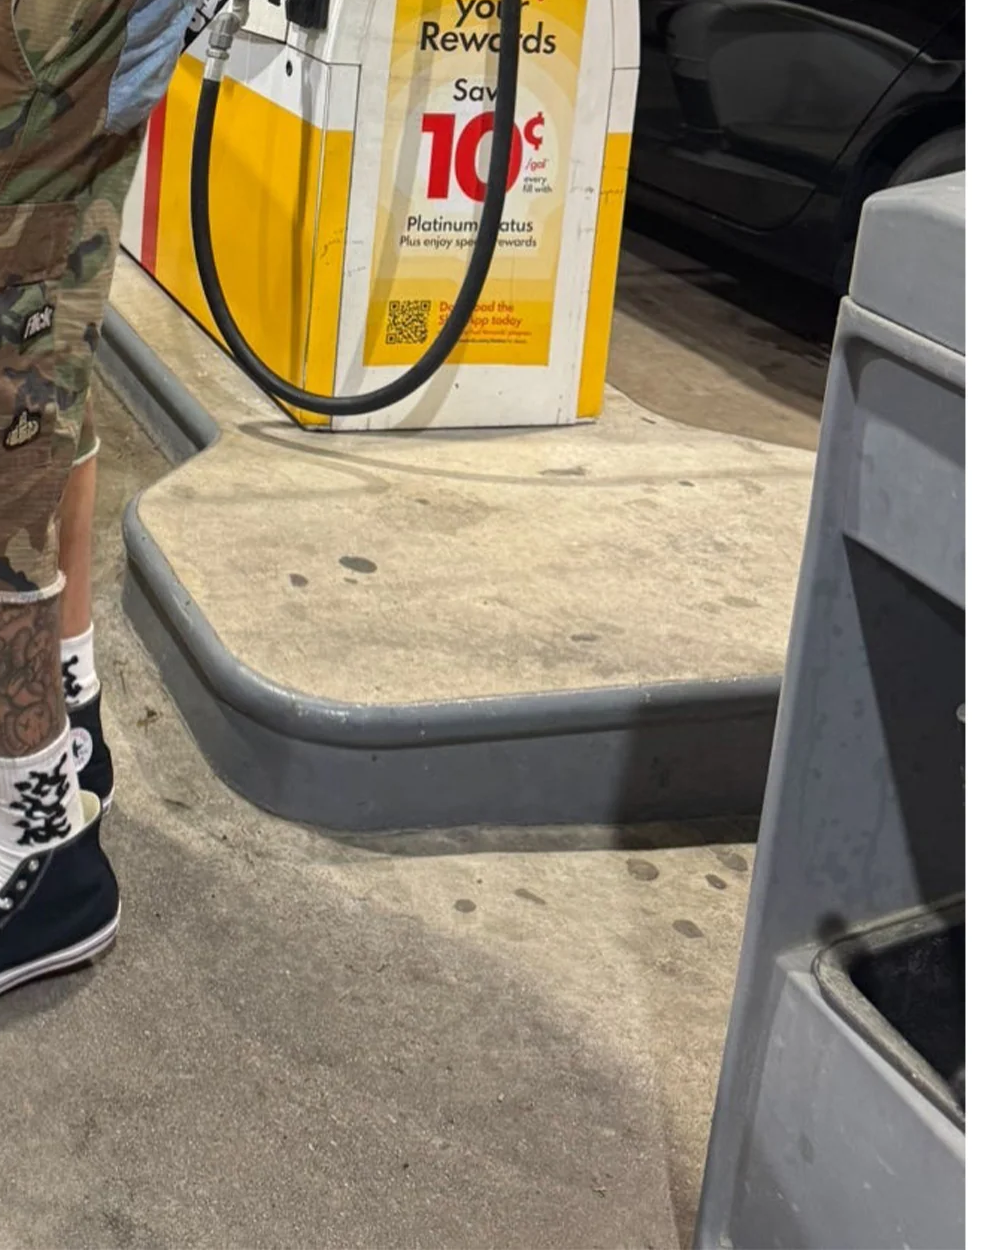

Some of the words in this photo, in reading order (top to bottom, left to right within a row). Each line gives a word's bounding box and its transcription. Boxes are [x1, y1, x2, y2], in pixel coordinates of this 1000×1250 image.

[420, 21, 557, 54] Rewads
[453, 78, 499, 103] Sav
[524, 175, 547, 185] every
[523, 184, 537, 194] fill
[537, 184, 553, 194] with
[407, 214, 478, 233] Platinum
[500, 217, 534, 233] atus
[400, 235, 421, 248] Plus
[423, 237, 453, 250] enjoy
[499, 236, 537, 248] ewards
[497, 301, 514, 313] the
[492, 313, 523, 328] today
